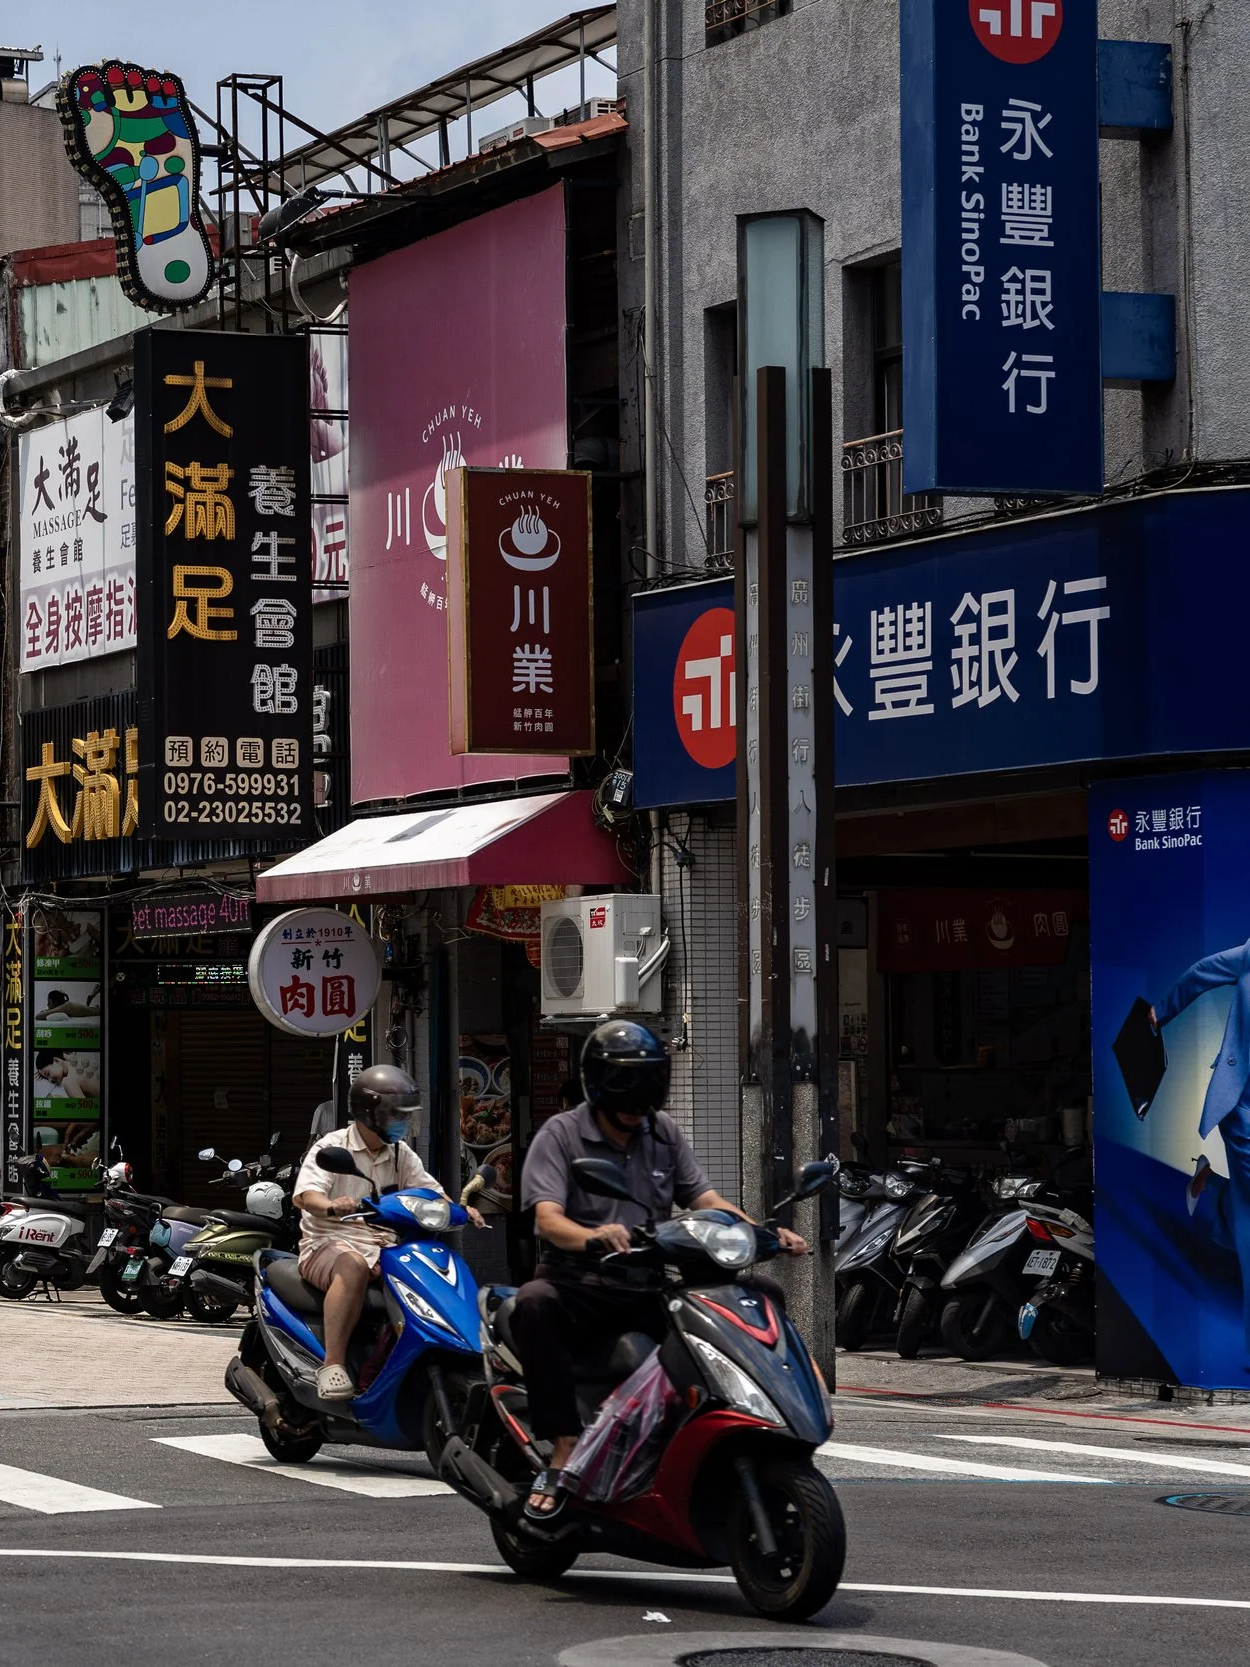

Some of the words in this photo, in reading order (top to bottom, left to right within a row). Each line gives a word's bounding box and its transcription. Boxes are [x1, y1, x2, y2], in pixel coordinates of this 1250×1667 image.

[960, 103, 985, 183] Bank
[960, 191, 986, 321] SinoPac
[999, 98, 1058, 416] 永豐銀行
[422, 405, 457, 443] CHUAN
[461, 405, 482, 429] YEH
[32, 436, 108, 523] 大滿足
[164, 360, 238, 642] 大滿足
[386, 487, 411, 550] 川
[498, 490, 535, 507] CHUAN
[539, 492, 561, 509] YEH
[33, 508, 83, 540] MASSAGE
[32, 537, 84, 574] 養生會館
[248, 465, 299, 715] 養生會館
[510, 585, 554, 694] 川業
[512, 707, 554, 720] 艋舺百年
[512, 720, 554, 733] 新竹肉圓
[167, 738, 299, 767] 預約電話
[25, 726, 138, 849] 大滿
[163, 772, 301, 798] 0976-599931
[791, 579, 814, 977] 廣州街行人徒步區
[163, 800, 302, 825] 02-23025532
[1135, 805, 1202, 833] 永豐銀行
[1135, 837, 1161, 851] Bank
[1161, 833, 1203, 849] SinoPac
[155, 902, 216, 934] massage
[290, 947, 344, 971] 新竹
[5, 920, 22, 1049] 大滿足
[279, 974, 356, 1019] 肉圓
